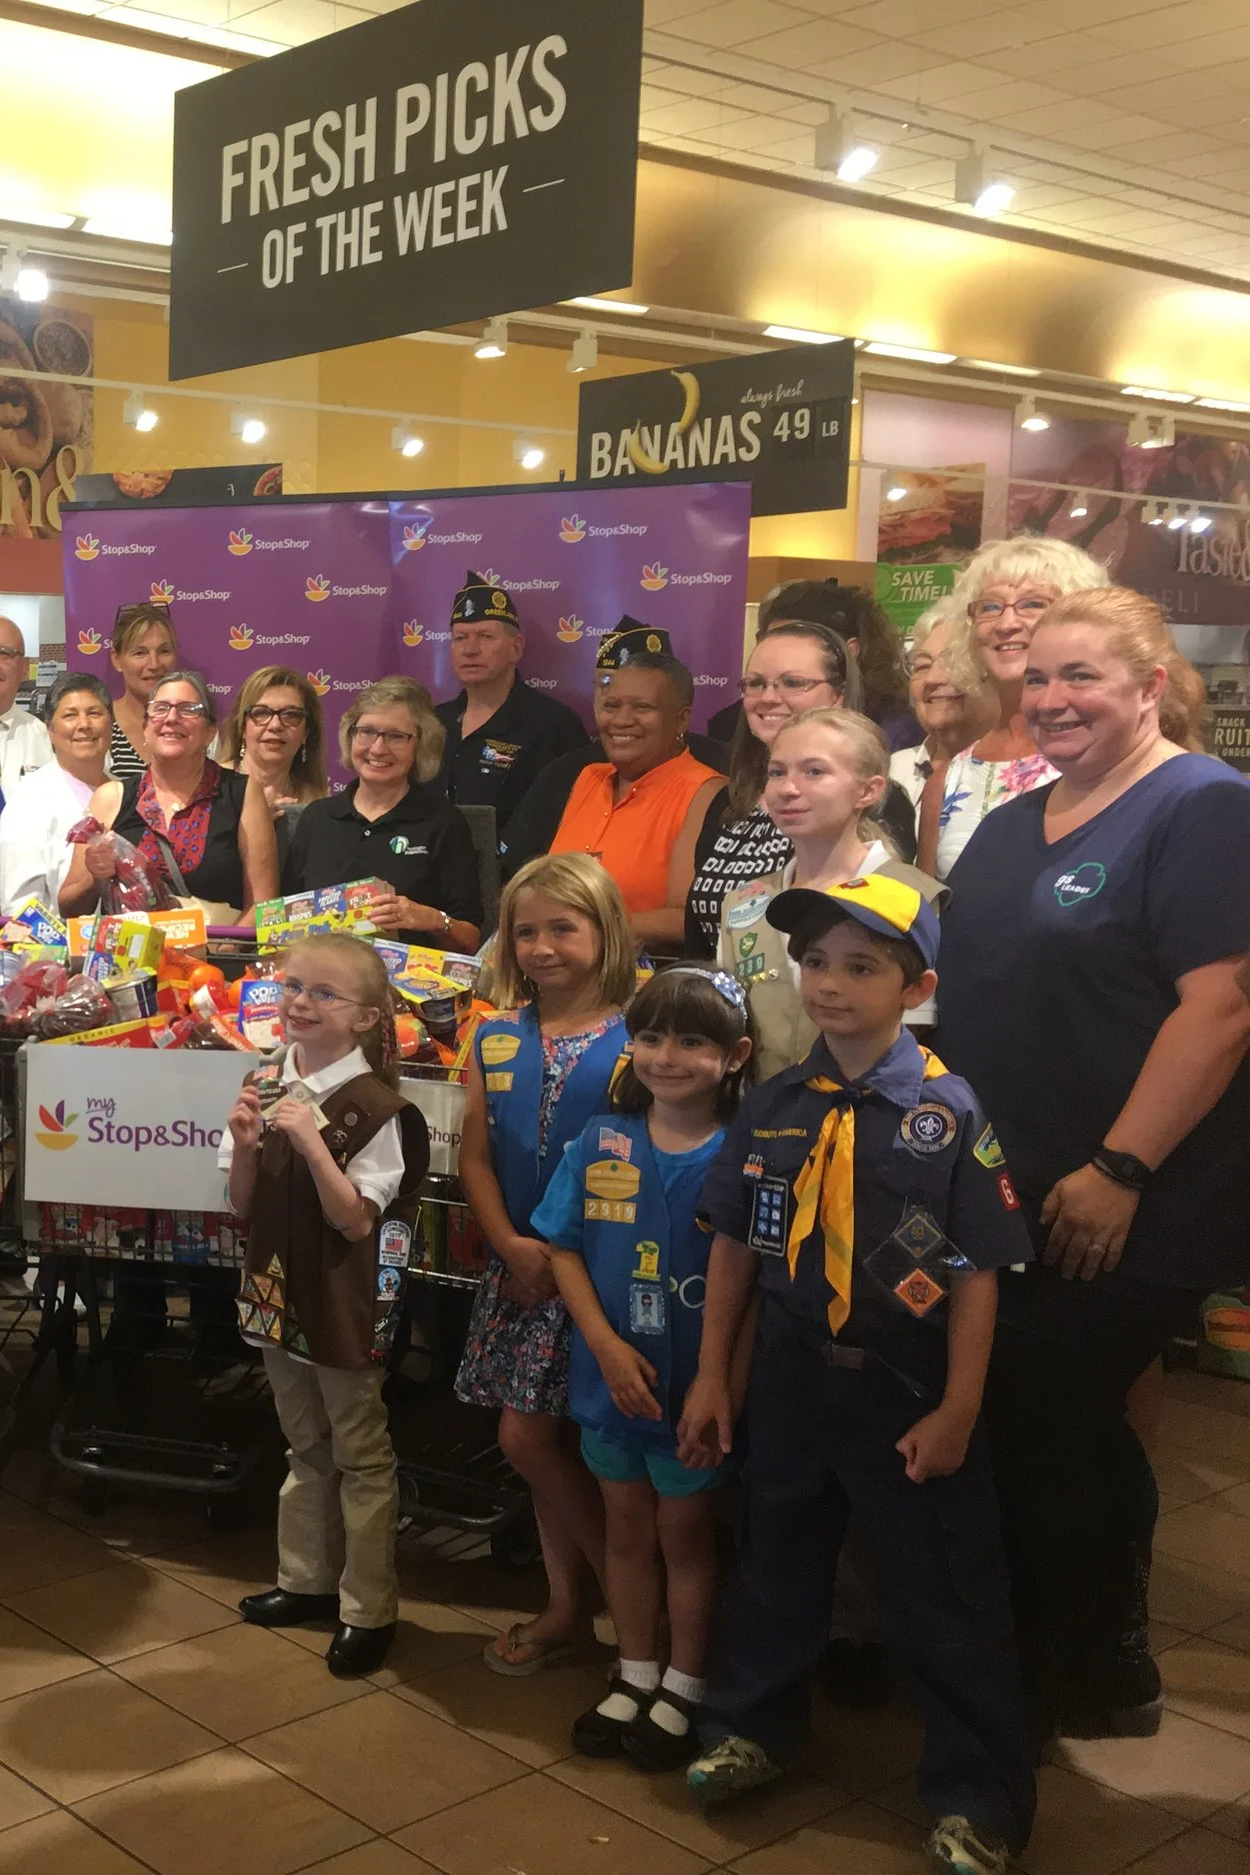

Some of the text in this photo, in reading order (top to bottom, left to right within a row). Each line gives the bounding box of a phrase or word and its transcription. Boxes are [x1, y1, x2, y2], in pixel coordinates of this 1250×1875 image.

[221, 34, 568, 225] FRESH PICKS
[262, 165, 509, 289] OF THE WEEK
[741, 379, 805, 409] always fresh
[590, 408, 839, 479] BANANAS 49 LB
[589, 524, 647, 537] Stop&Shop
[255, 538, 310, 550] Stop&Shop
[428, 532, 482, 544] Stop&Shop
[102, 543, 155, 555] Stop&Shop
[671, 572, 732, 585] Stop&Shop
[892, 570, 935, 586] SAVE
[333, 585, 387, 597] Stop&Shop
[503, 579, 559, 592] Stop&Shop
[177, 590, 230, 602] Stop&Shop
[256, 634, 310, 646] Stop&Shop
[1216, 717, 1245, 727] SNACK
[86, 1097, 116, 1118] my
[87, 1117, 223, 1152] Stop&Sho
